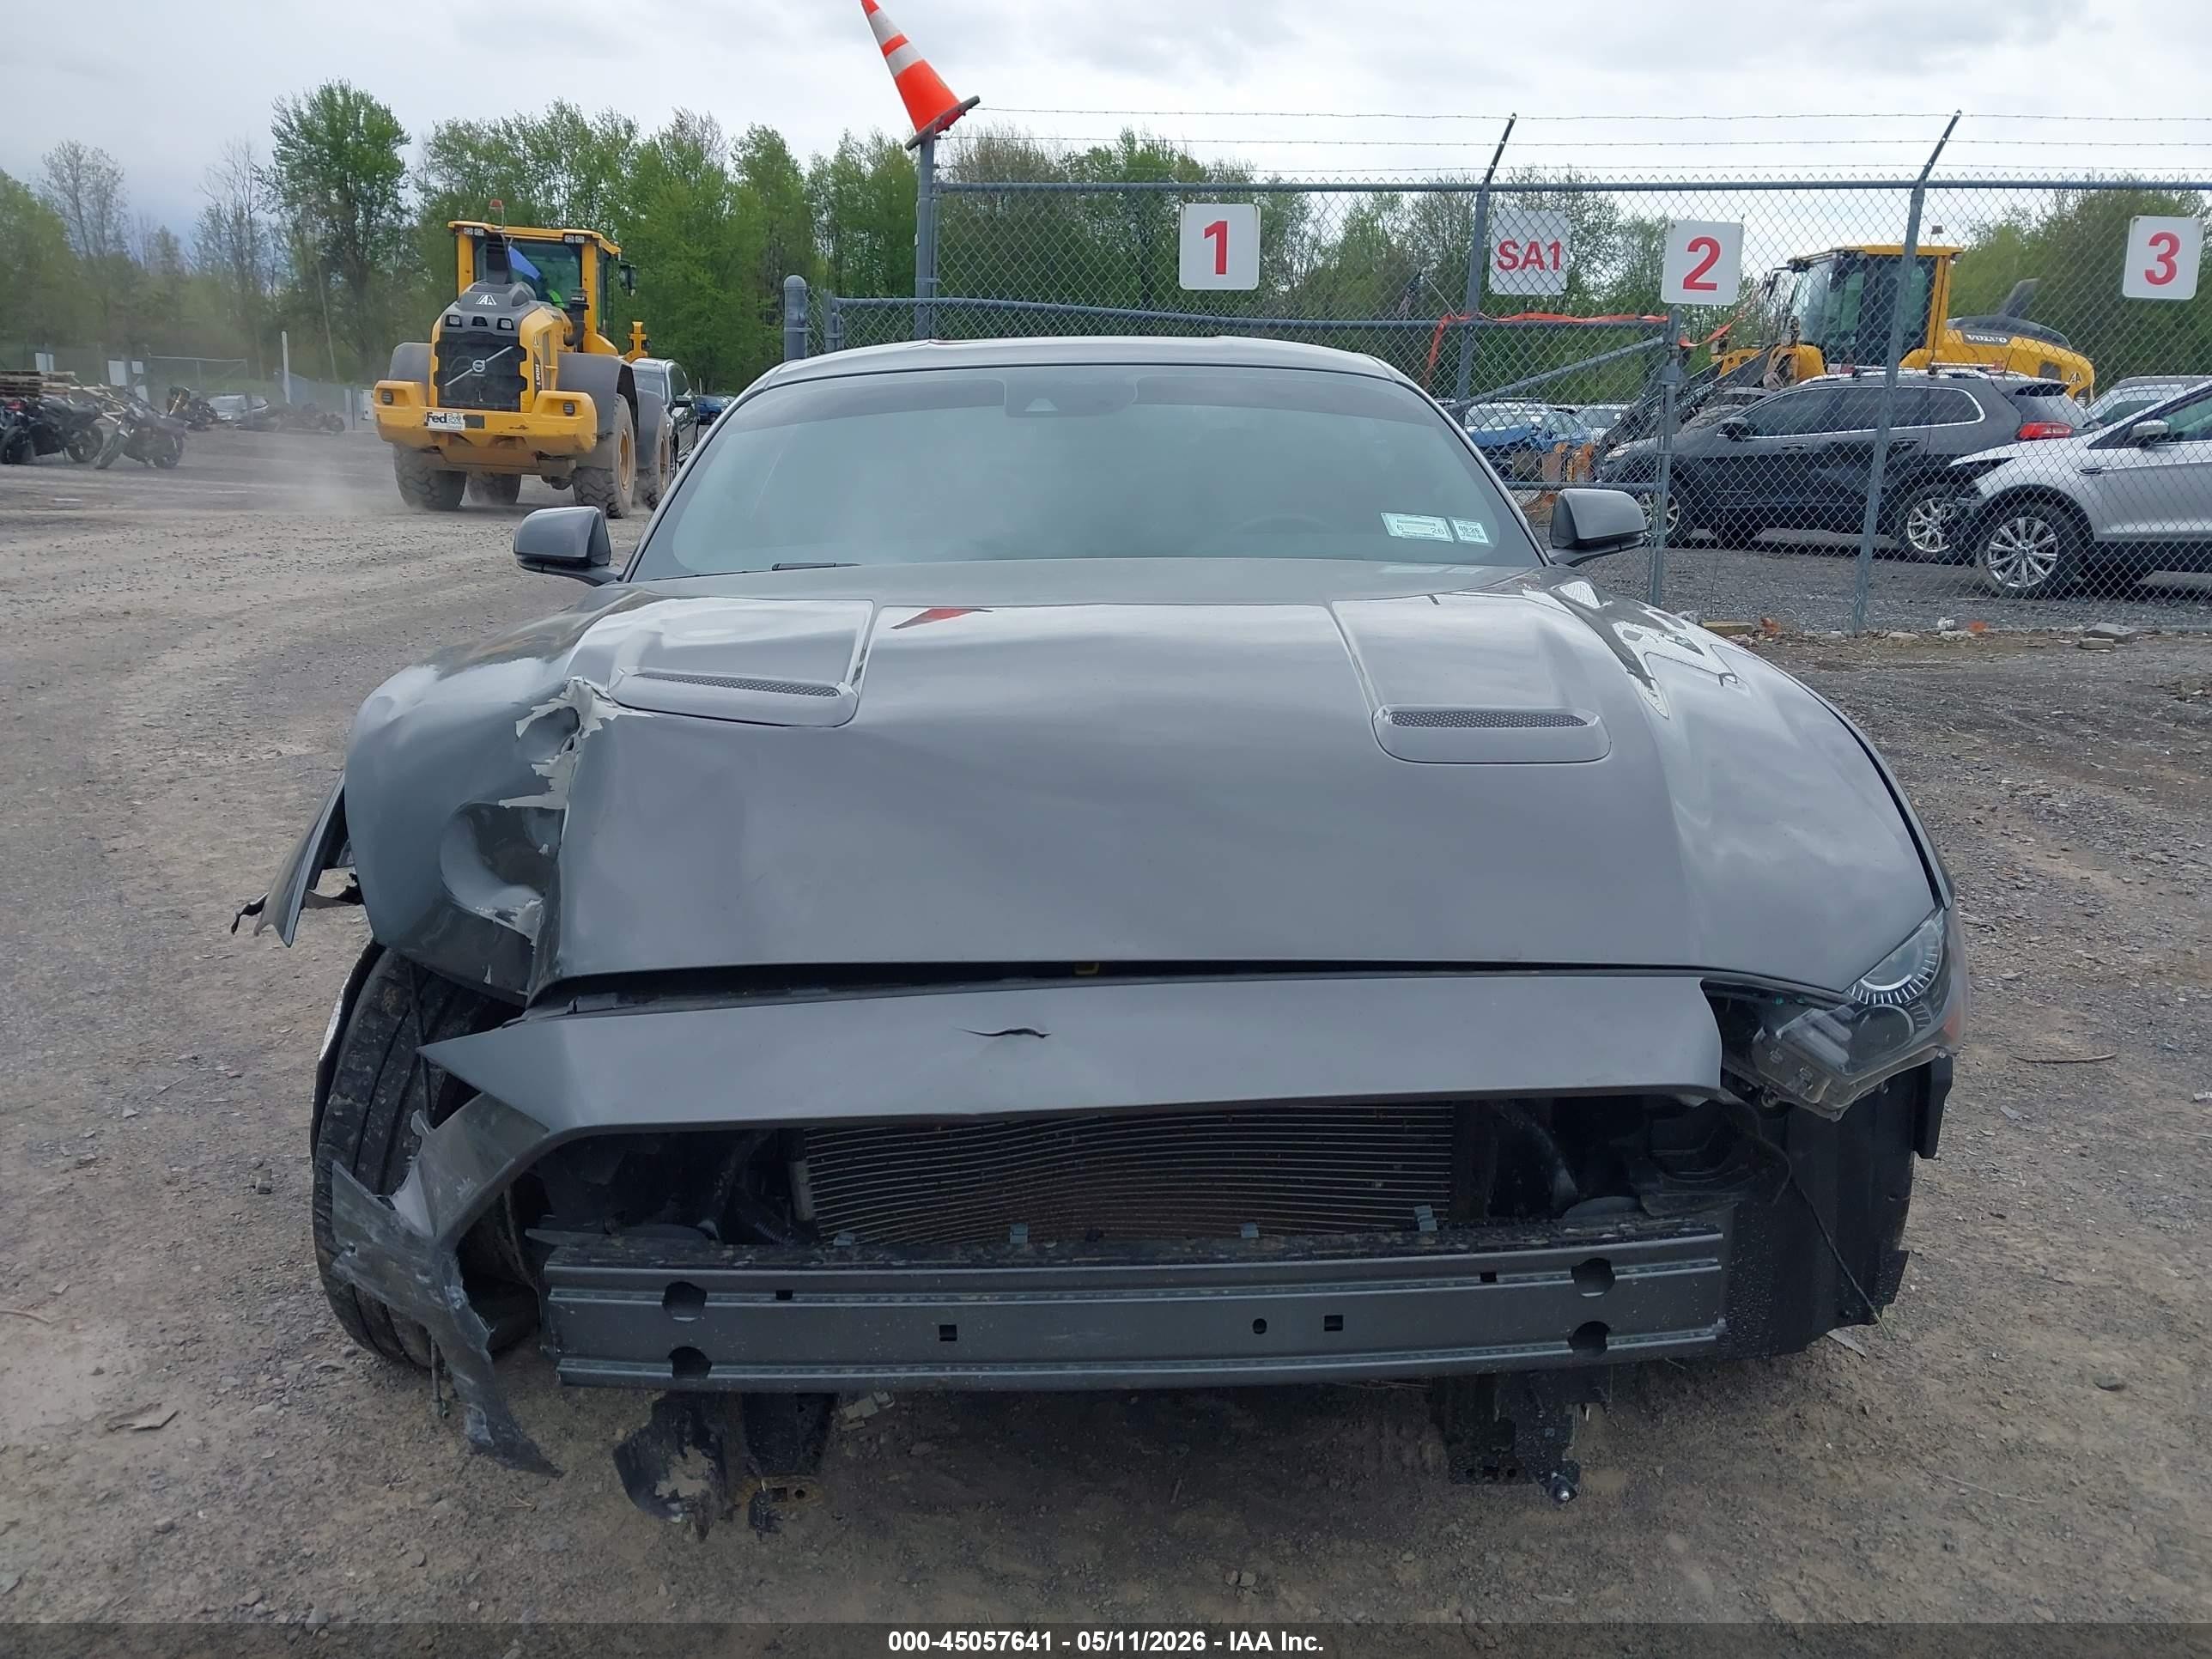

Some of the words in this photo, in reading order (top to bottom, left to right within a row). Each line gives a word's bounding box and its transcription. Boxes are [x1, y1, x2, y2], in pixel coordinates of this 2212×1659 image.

[1204, 222, 1228, 275] 1
[1497, 240, 1561, 270] SA1
[1682, 236, 1722, 291] 2
[2144, 232, 2180, 286] 3
[1680, 395, 1695, 408] NOT
[1695, 383, 1716, 398] WALK
[427, 411, 461, 424] FedEx
